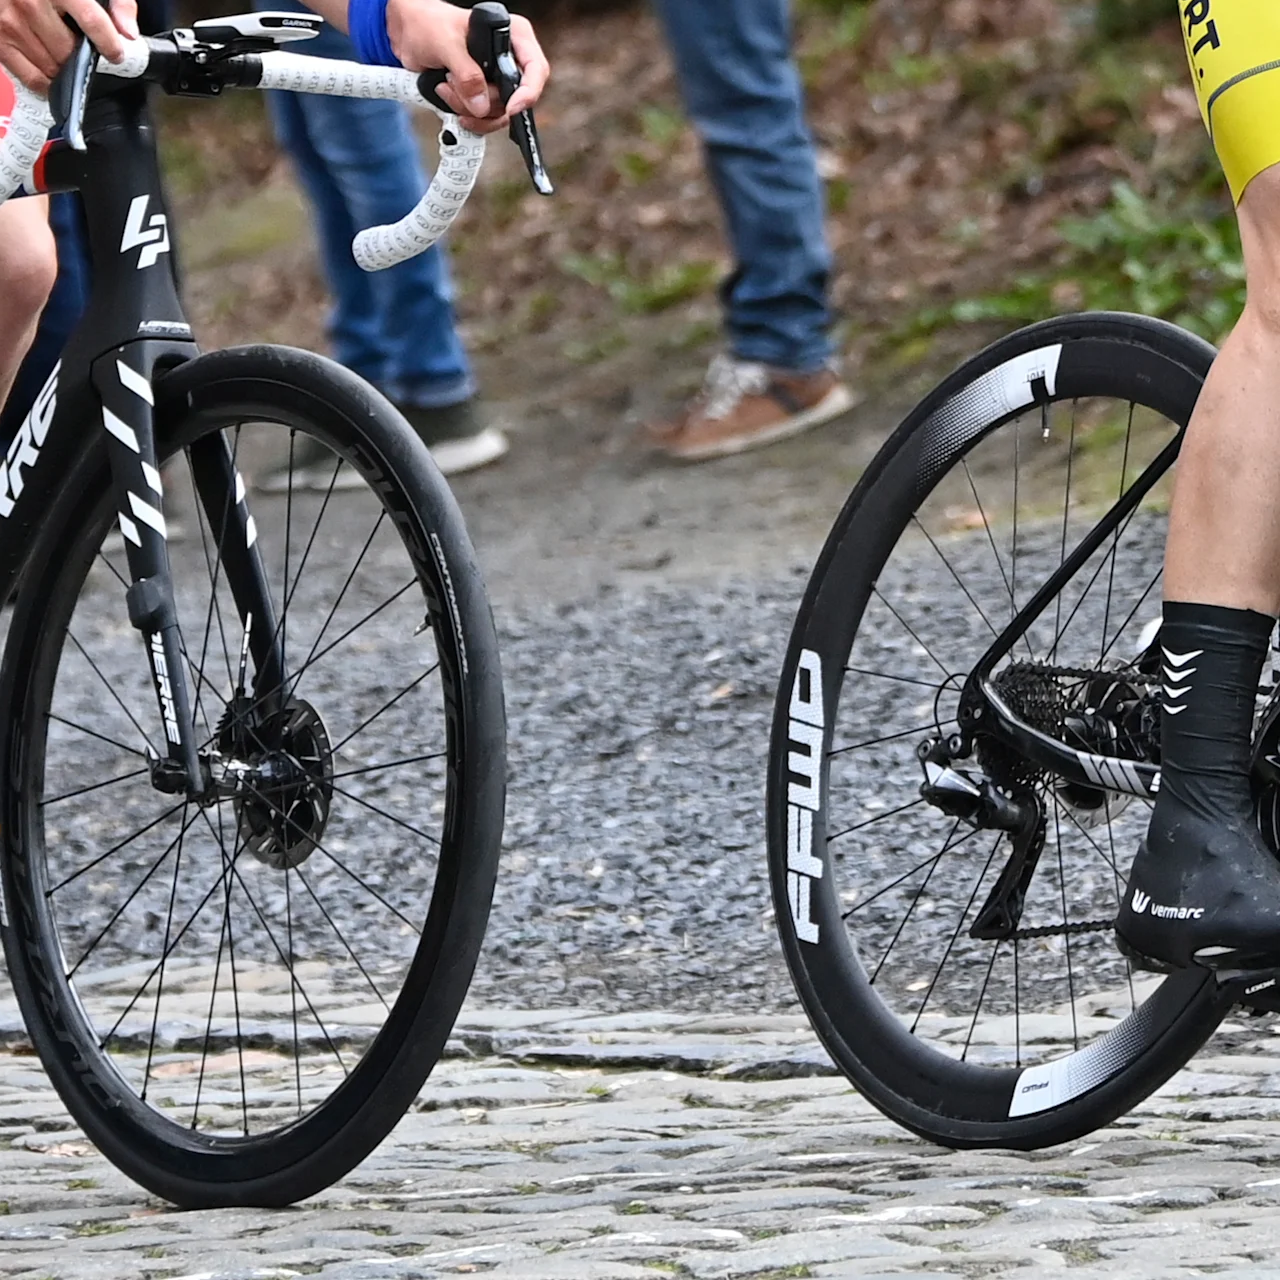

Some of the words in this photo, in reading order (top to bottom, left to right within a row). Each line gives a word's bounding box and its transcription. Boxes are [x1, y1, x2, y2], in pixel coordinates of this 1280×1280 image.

[282, 19, 313, 28] GARMIN
[430, 531, 469, 676] CONTINENTAL
[786, 648, 826, 945] FFWD
[1150, 902, 1205, 920] vermarc
[1244, 977, 1276, 995] LOOK
[1021, 1080, 1050, 1095] FFWD
